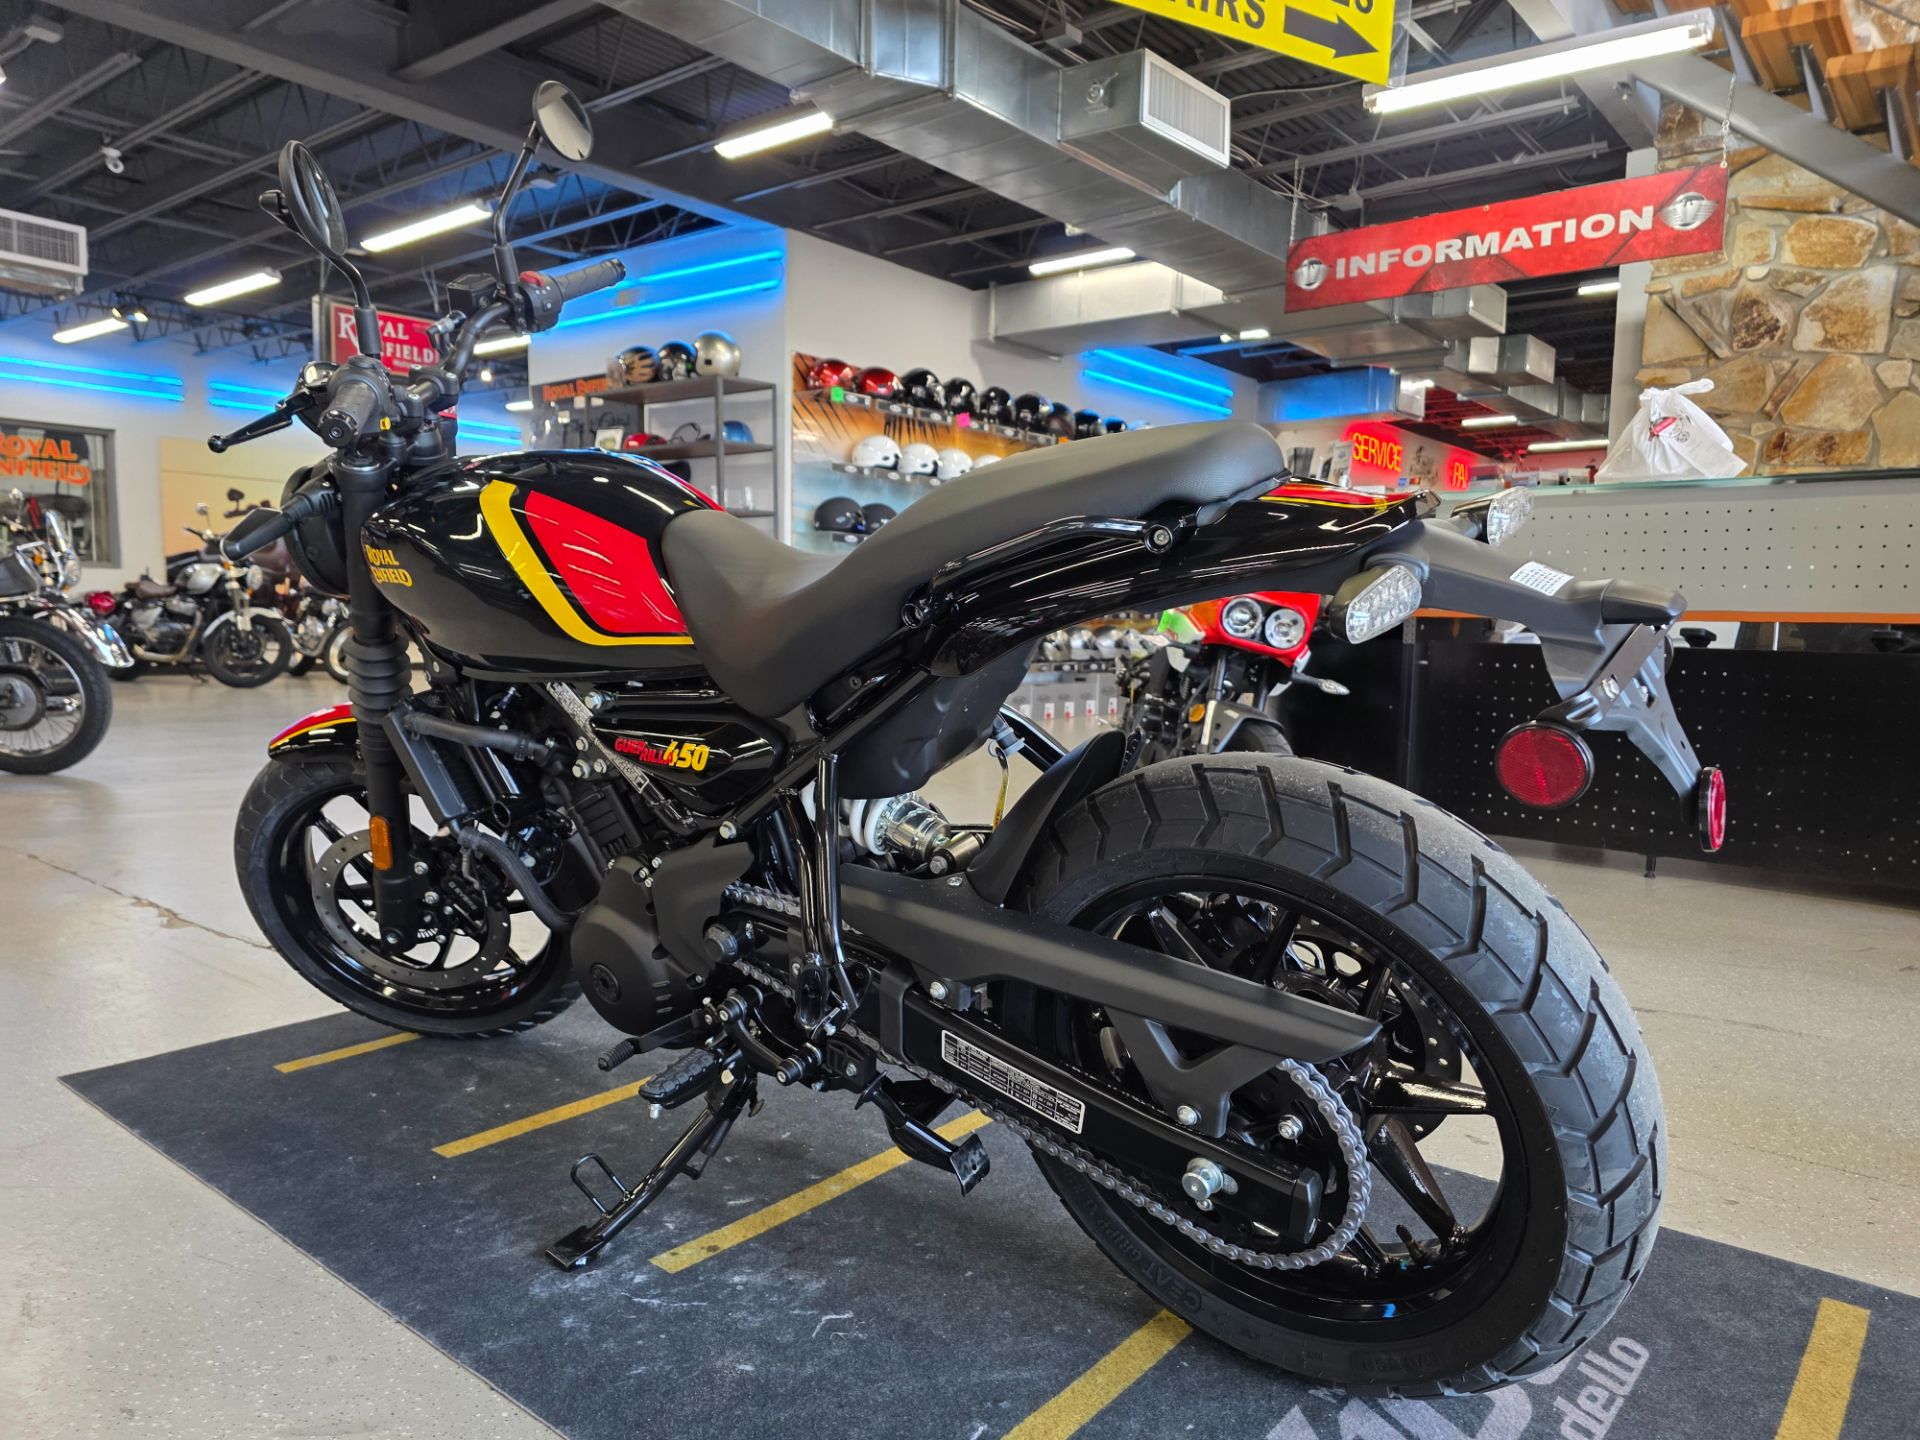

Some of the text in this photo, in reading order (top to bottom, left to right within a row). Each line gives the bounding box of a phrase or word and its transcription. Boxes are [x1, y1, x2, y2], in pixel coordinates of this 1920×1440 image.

[1335, 205, 1653, 279] INFORMATION
[338, 312, 409, 354] RAL
[1352, 432, 1402, 472] SERVICE
[365, 544, 399, 566] ROYAL
[663, 741, 710, 771] 450
